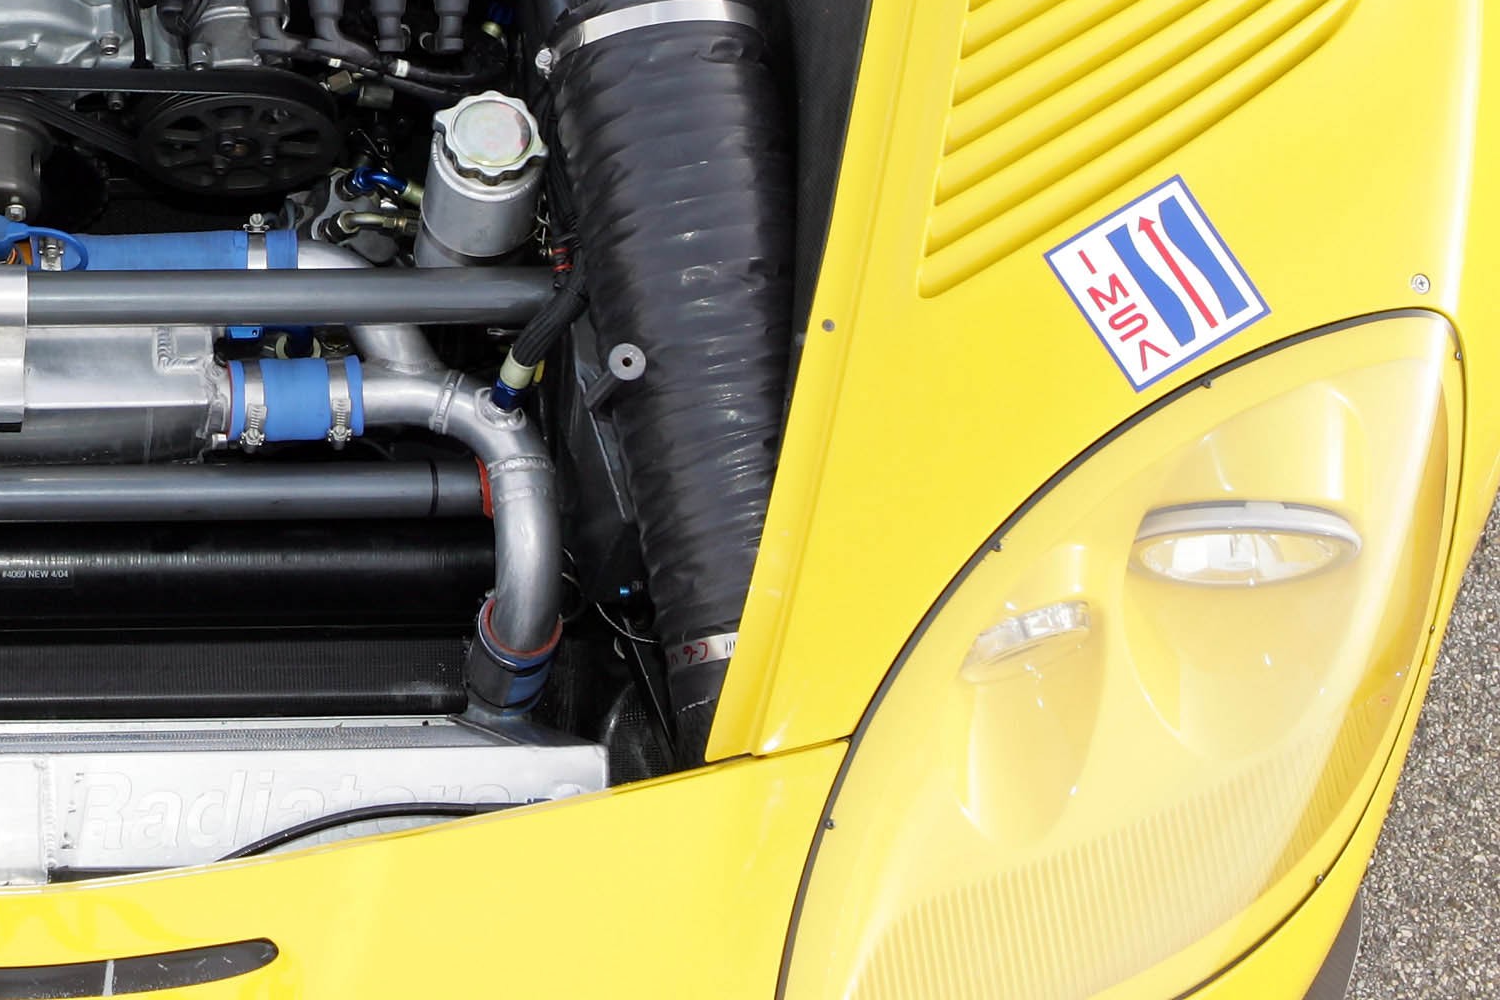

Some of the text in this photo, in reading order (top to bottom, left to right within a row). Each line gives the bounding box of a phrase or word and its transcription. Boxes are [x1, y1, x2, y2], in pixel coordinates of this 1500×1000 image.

[1077, 249, 1171, 372] IMSA
[28, 569, 49, 578] NEW
[50, 569, 69, 578] 4/04
